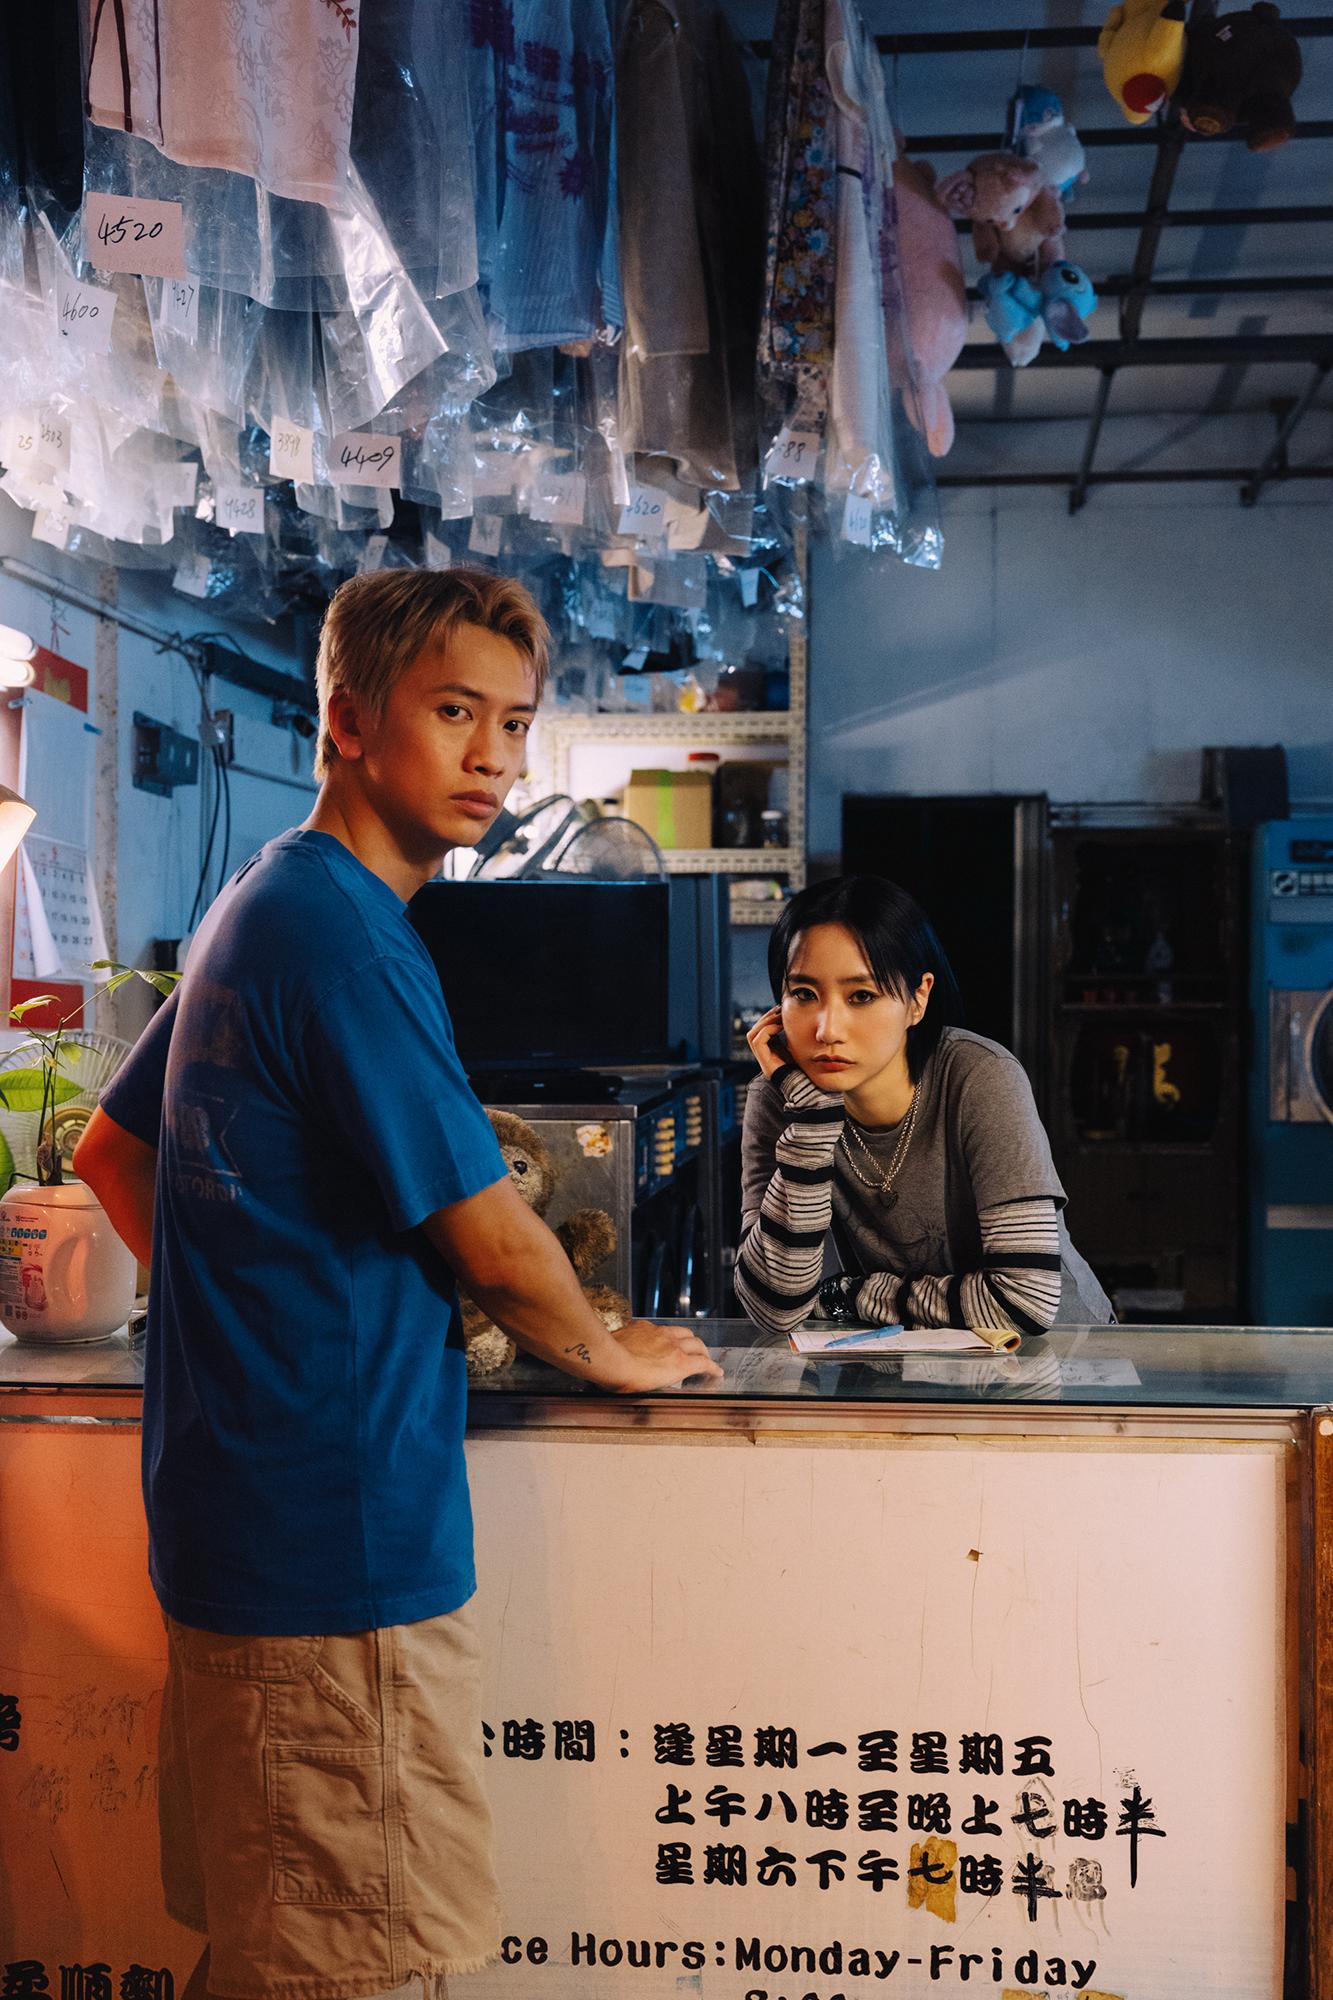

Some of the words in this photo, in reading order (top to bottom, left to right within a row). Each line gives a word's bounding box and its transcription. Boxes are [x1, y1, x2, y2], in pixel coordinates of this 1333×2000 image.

[98, 213, 164, 246] 4520
[62, 292, 99, 321] 4600
[341, 446, 394, 473] 4409
